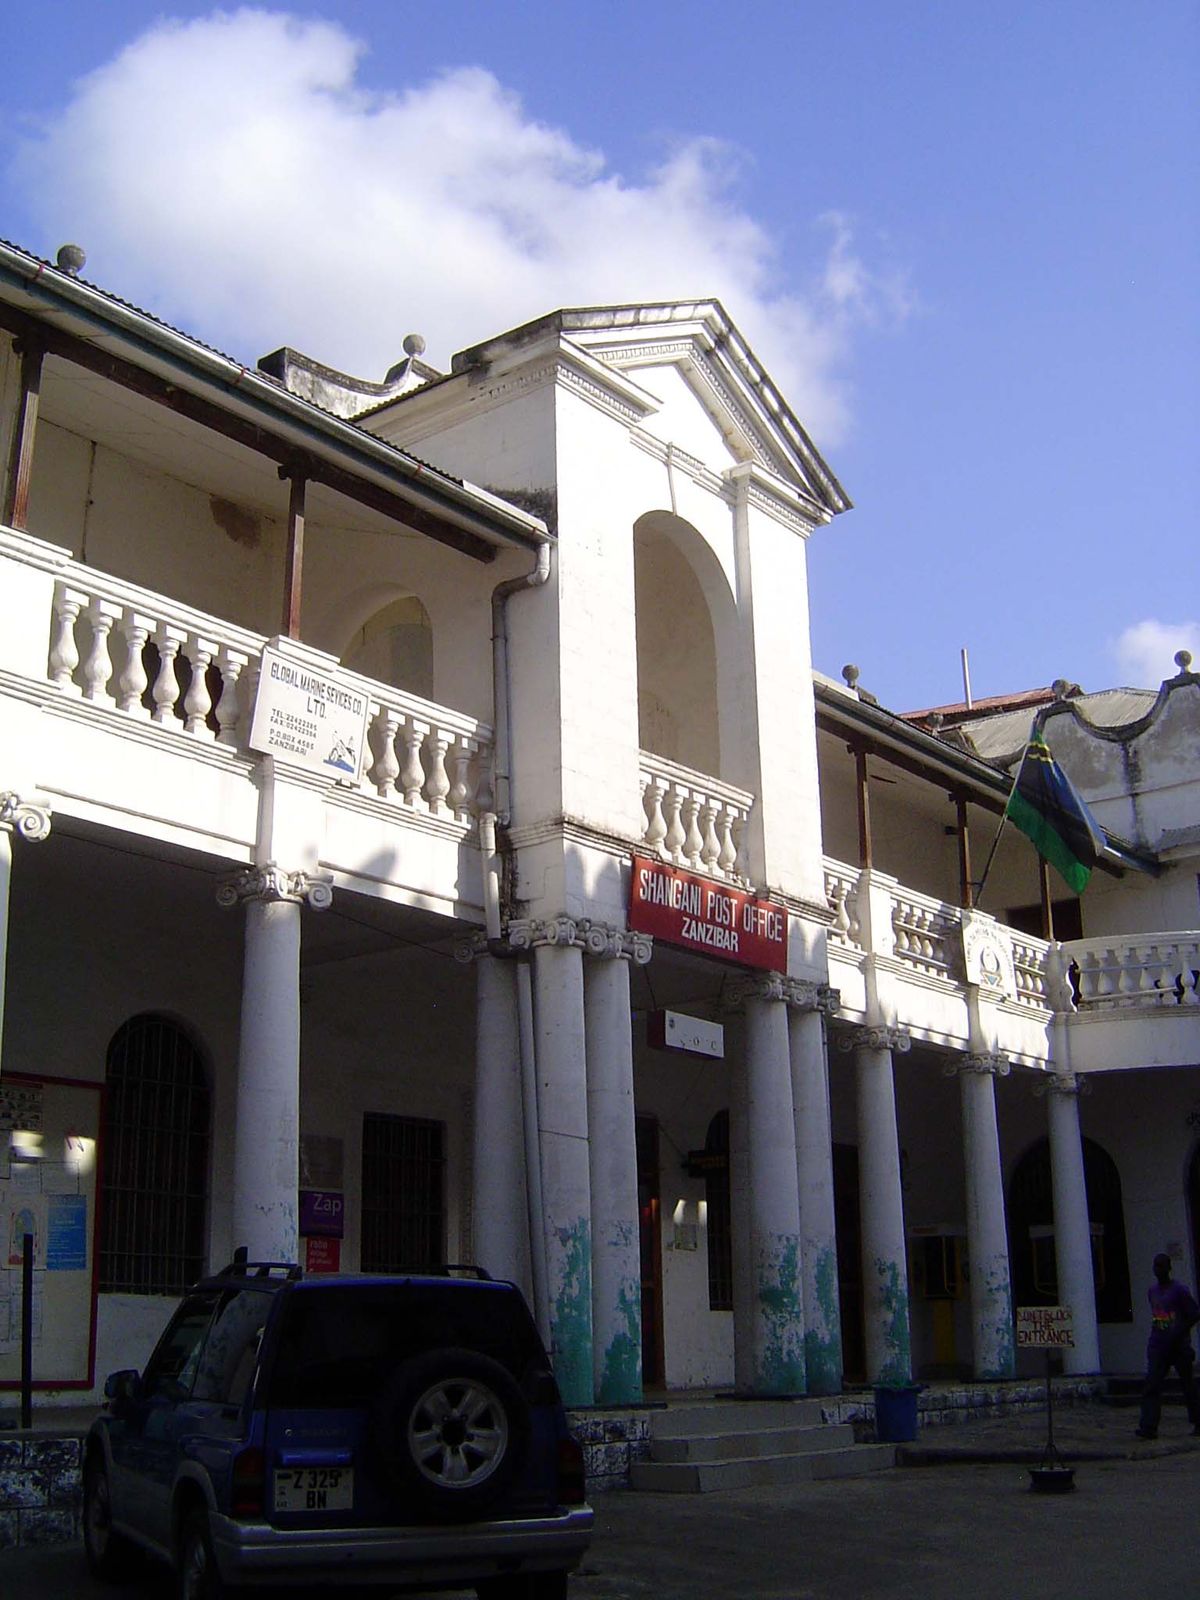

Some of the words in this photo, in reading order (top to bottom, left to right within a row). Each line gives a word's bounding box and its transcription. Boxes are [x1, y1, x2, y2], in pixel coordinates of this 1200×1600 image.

[270, 662, 299, 688] GLOBAL
[299, 674, 326, 699] MARINE
[639, 868, 701, 917] SHANGANI
[706, 890, 738, 928] POST
[743, 903, 783, 942] OFFICE
[681, 916, 739, 952] ZANZIBAR
[312, 1193, 342, 1217] Zap
[1031, 1320, 1054, 1331] THE
[1018, 1329, 1073, 1344] ENTRANCE
[293, 1470, 304, 1489] Z
[306, 1490, 327, 1509] BN
